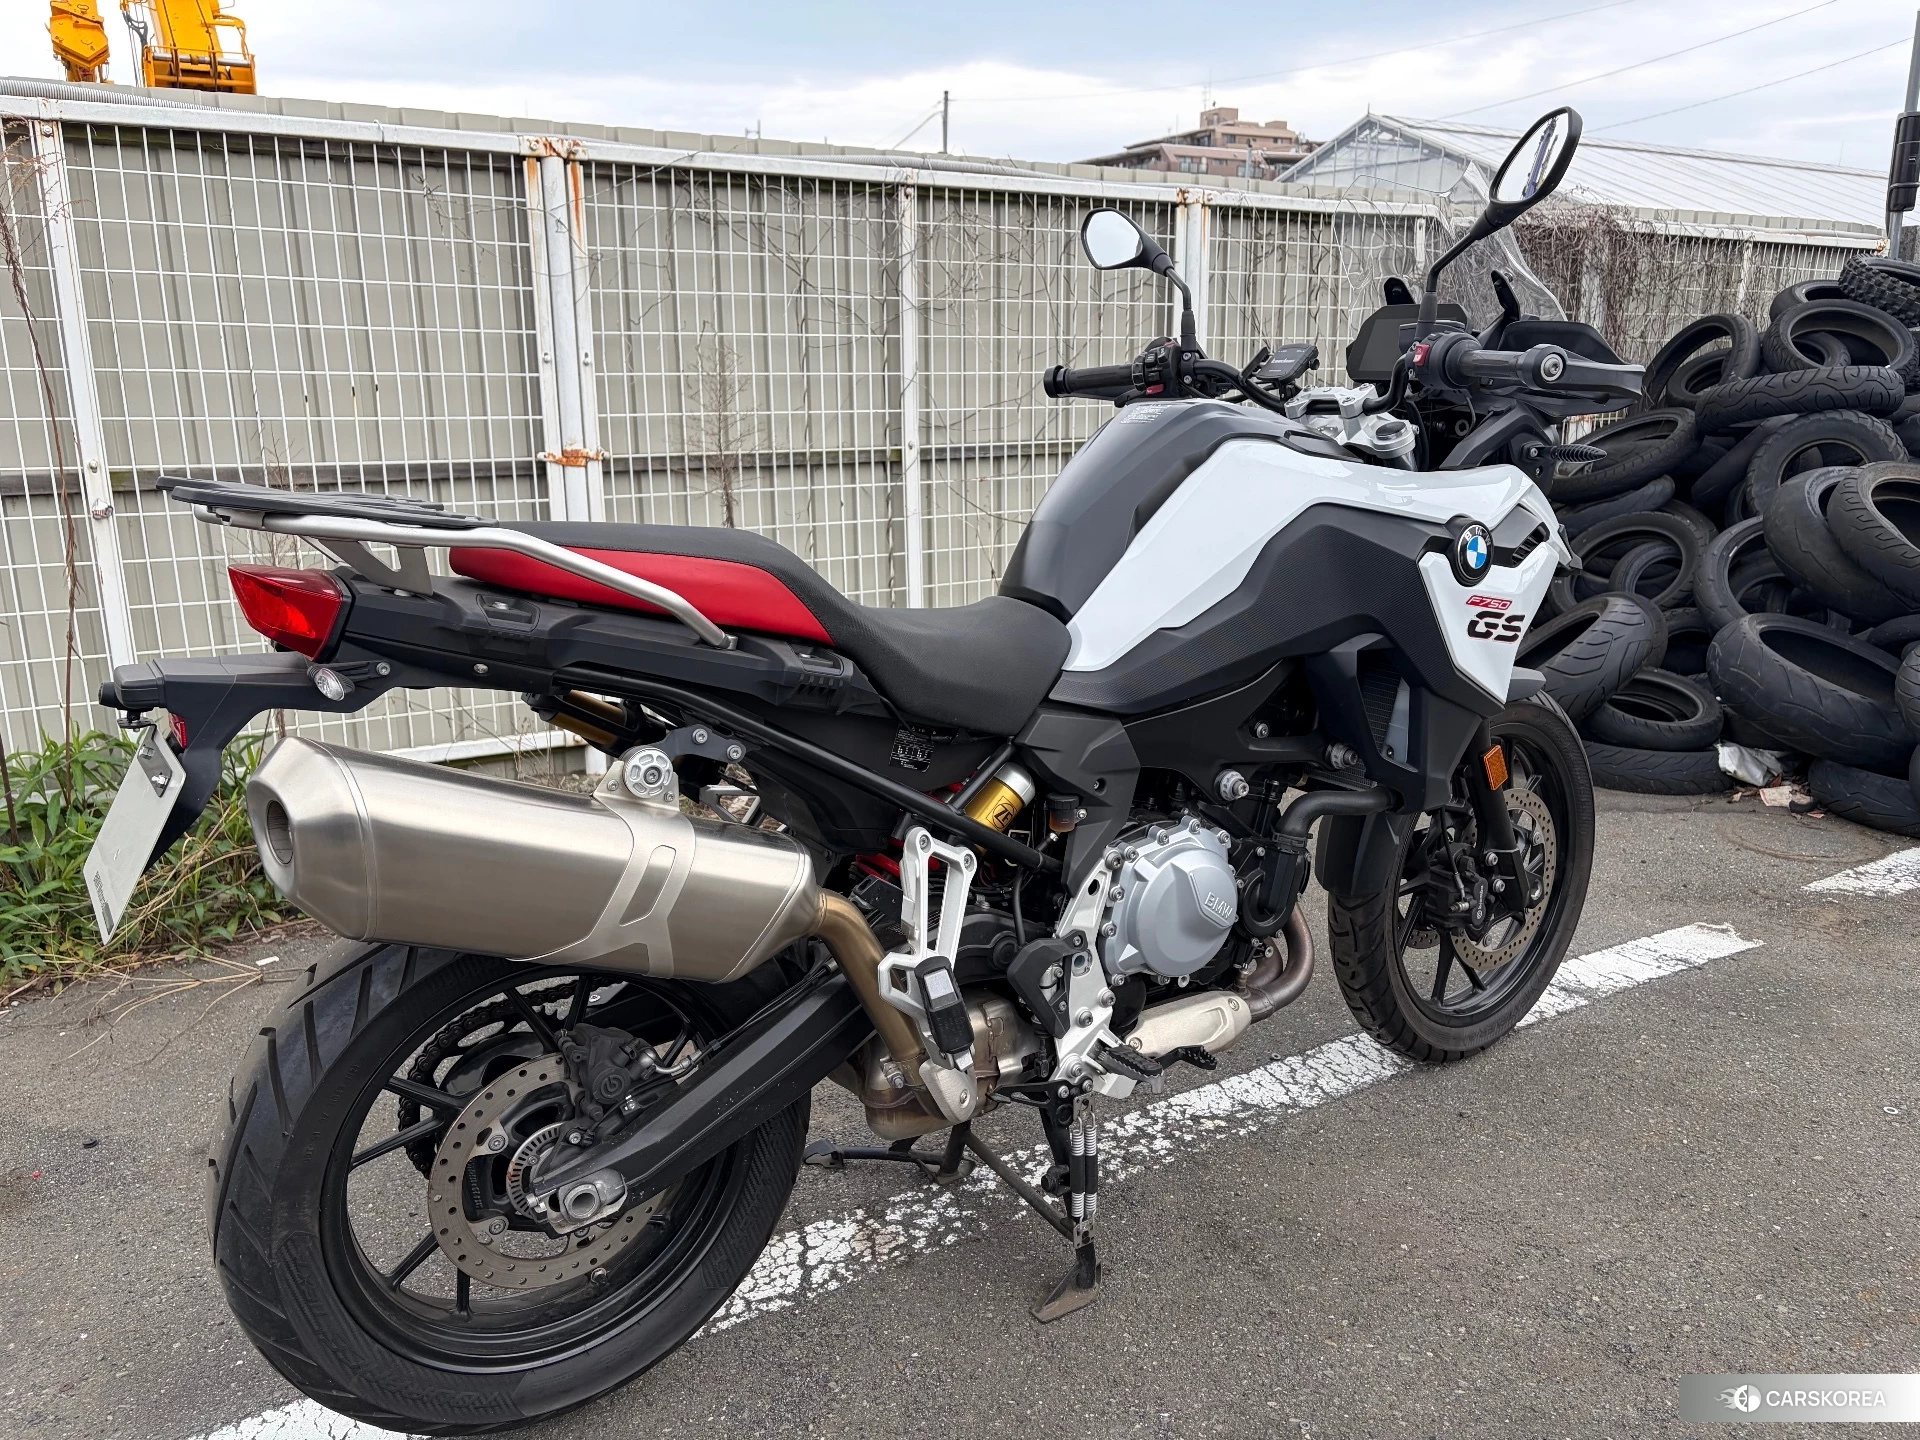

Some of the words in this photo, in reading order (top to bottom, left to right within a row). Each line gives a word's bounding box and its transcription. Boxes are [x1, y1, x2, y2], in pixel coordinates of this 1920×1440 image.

[1464, 526, 1491, 546] BMW
[1468, 596, 1511, 609] F750
[1467, 610, 1526, 642] GS
[994, 803, 1013, 828] ZF
[1204, 891, 1234, 919] BMW
